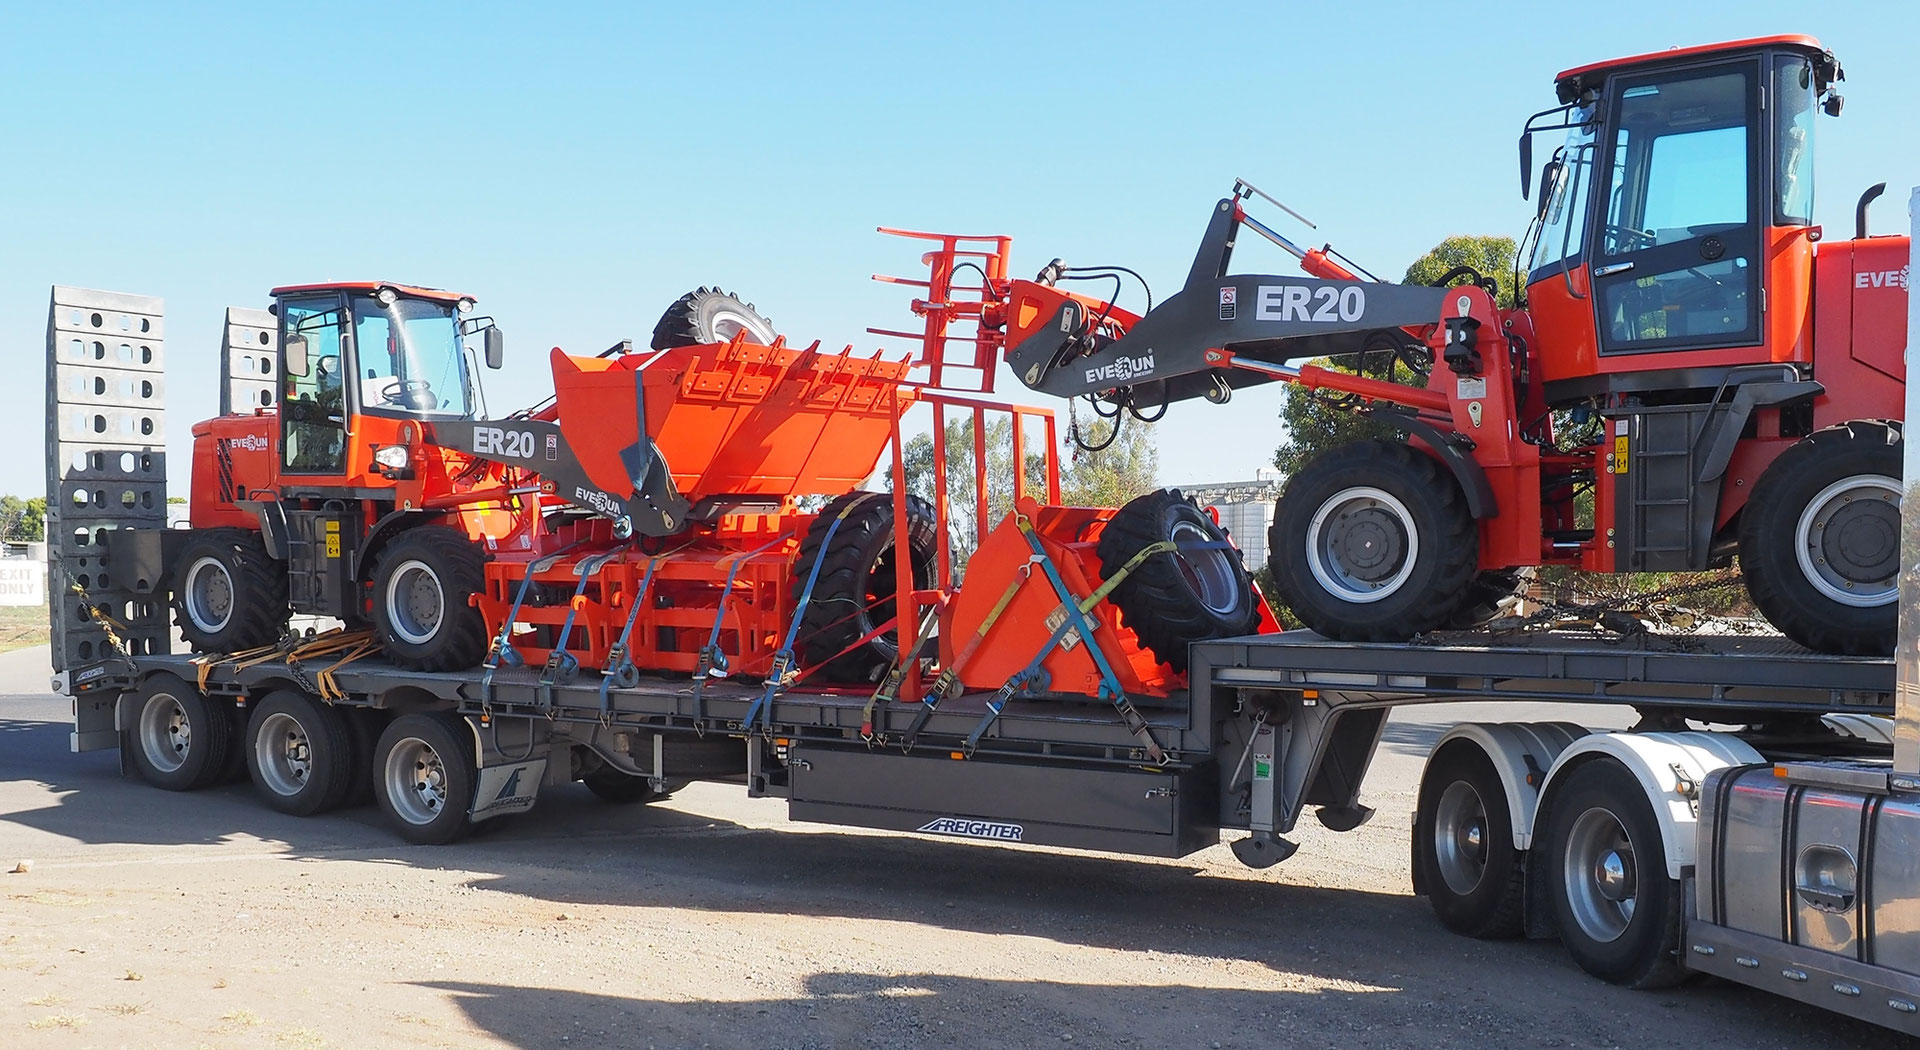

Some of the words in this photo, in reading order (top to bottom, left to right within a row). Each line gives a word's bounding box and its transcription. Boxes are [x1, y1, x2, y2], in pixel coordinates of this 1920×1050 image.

[1256, 285, 1366, 323] ER20
[1085, 355, 1155, 383] EVERUN
[231, 434, 268, 451] EVERUN
[473, 426, 535, 459] ER20
[0, 569, 32, 580] EXIT
[0, 583, 34, 595] ONLY
[918, 818, 1023, 840] FREIGHTER
